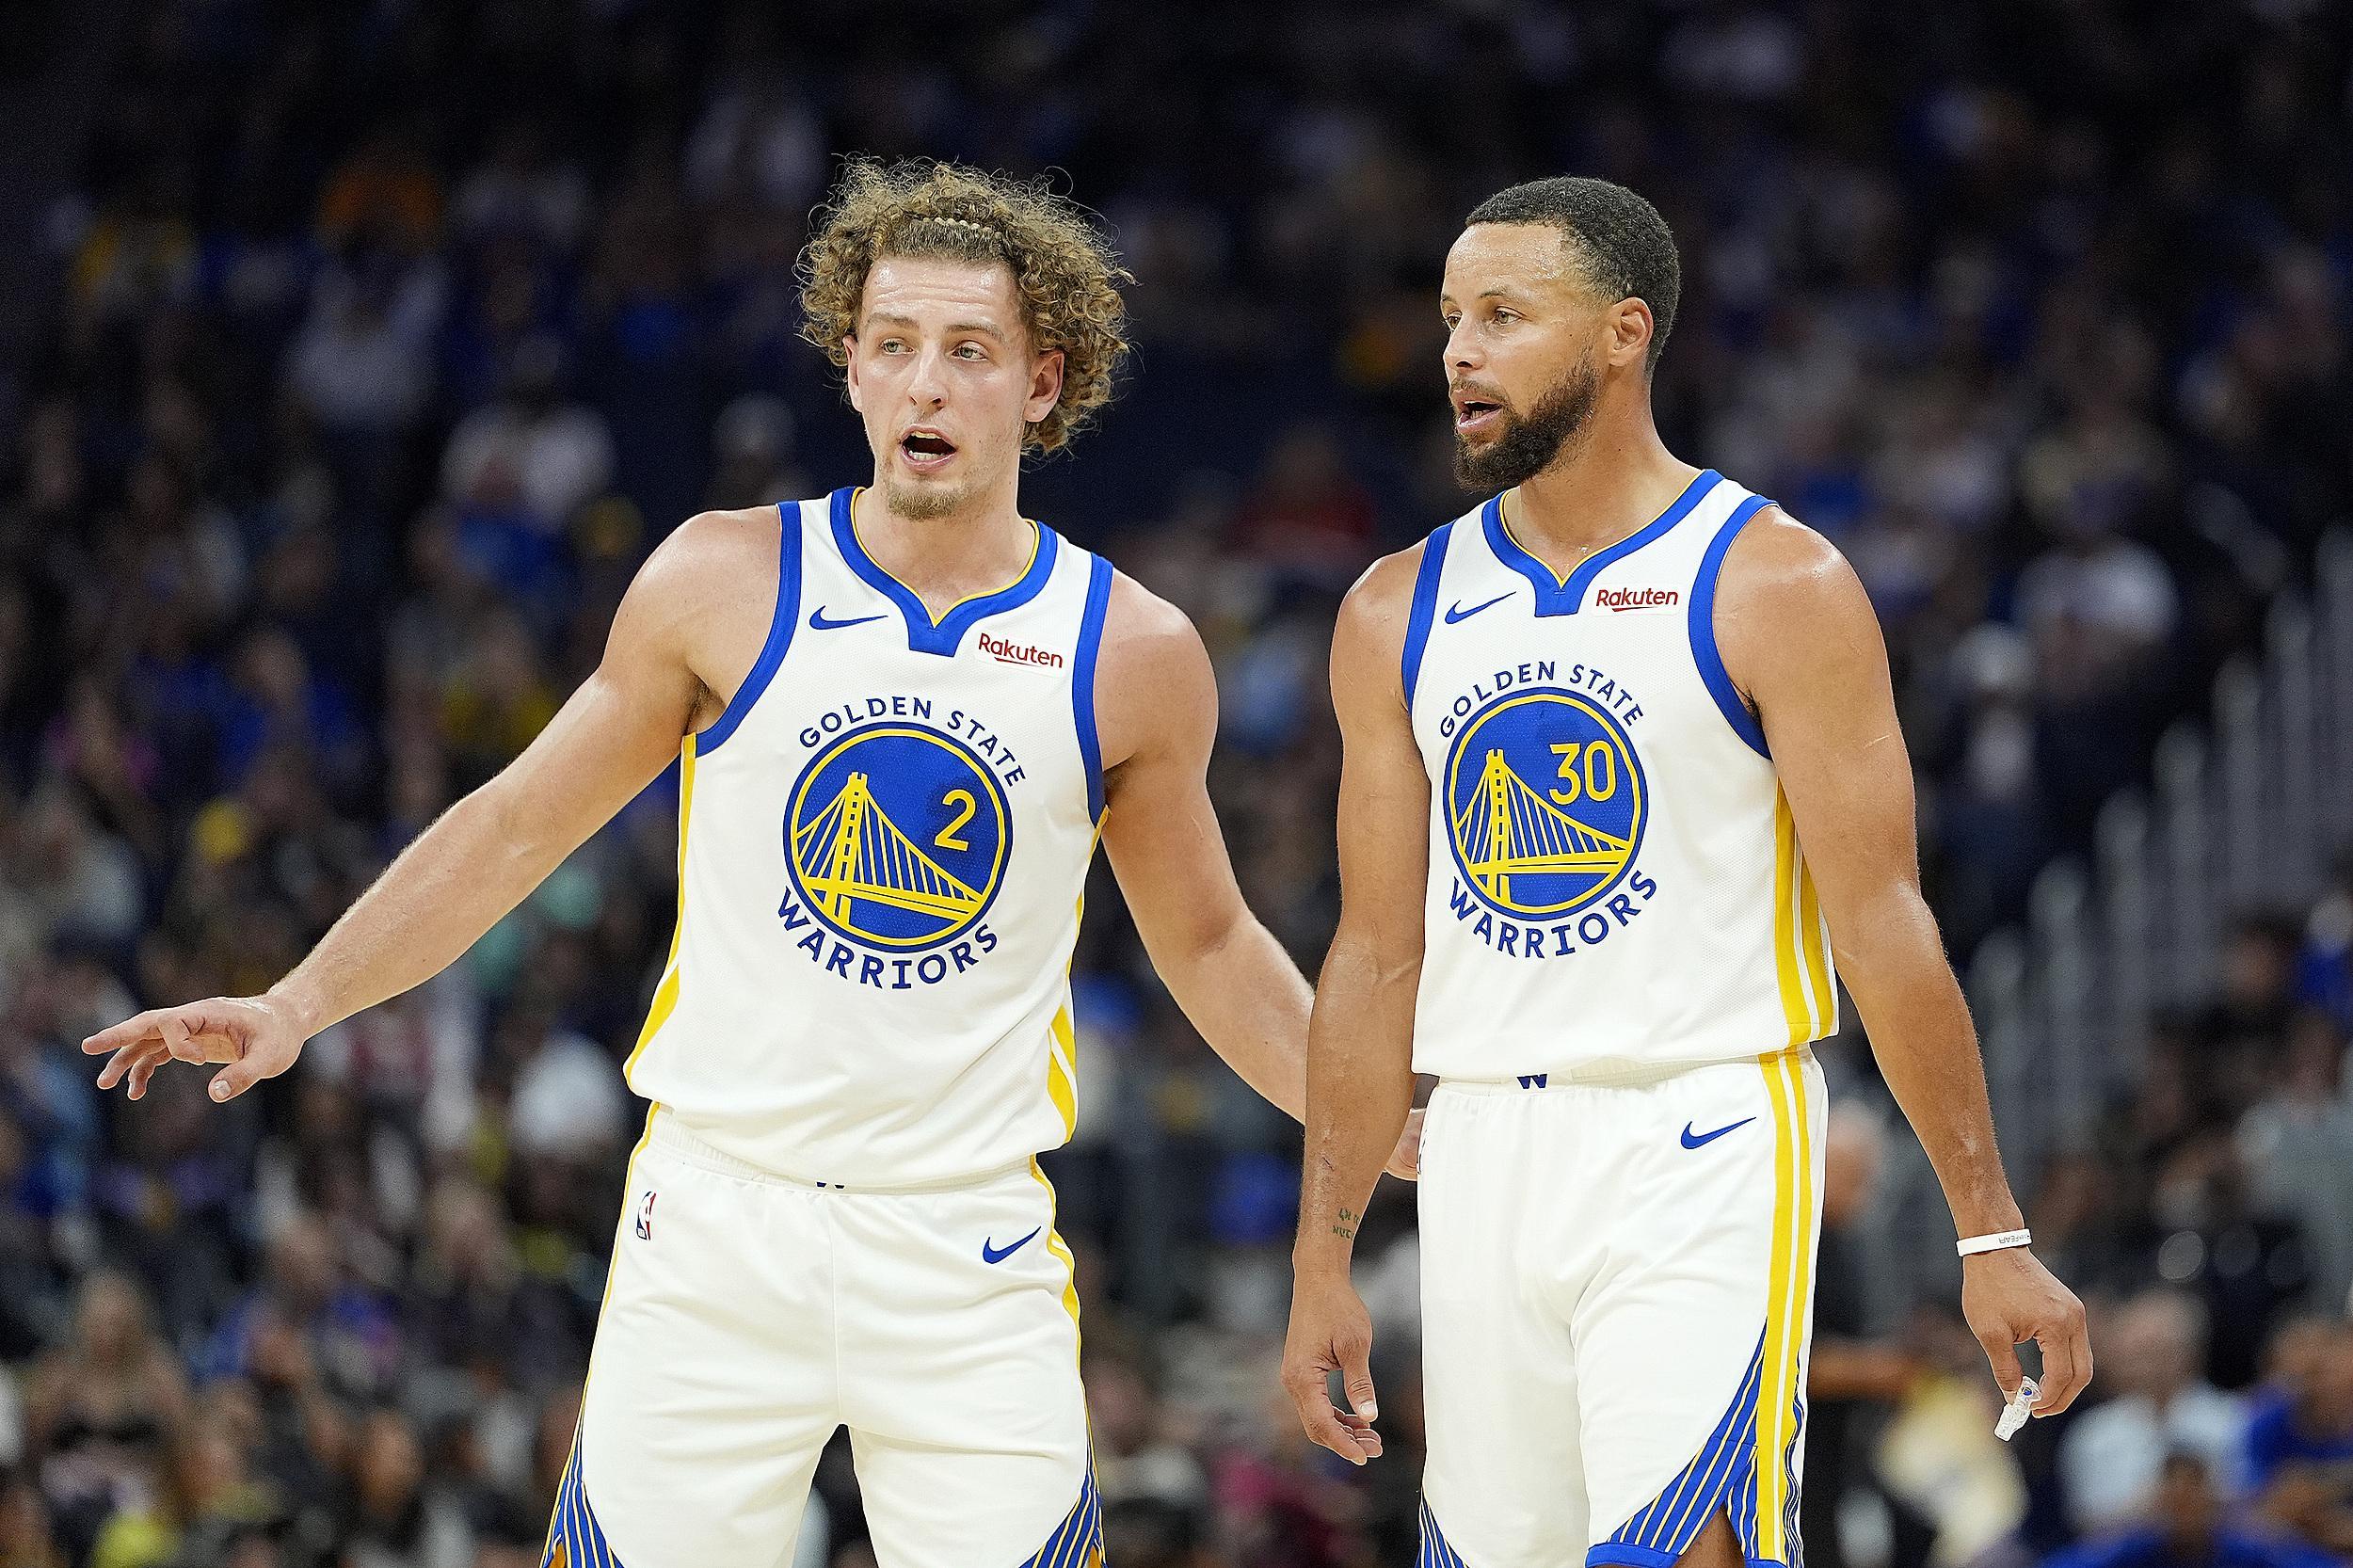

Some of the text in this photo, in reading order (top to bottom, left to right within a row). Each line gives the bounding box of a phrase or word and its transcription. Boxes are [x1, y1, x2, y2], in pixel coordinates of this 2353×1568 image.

[1595, 587, 1679, 608] Rakuten
[978, 632, 1064, 669] Rakuten
[1440, 661, 1644, 739] GOLDEN STATE
[800, 696, 1027, 788] GOLDEN STATE
[1548, 740, 1618, 805] 30
[934, 789, 978, 851] 2
[777, 886, 998, 990] WARRIORS
[1450, 869, 1657, 960] WARRIORS
